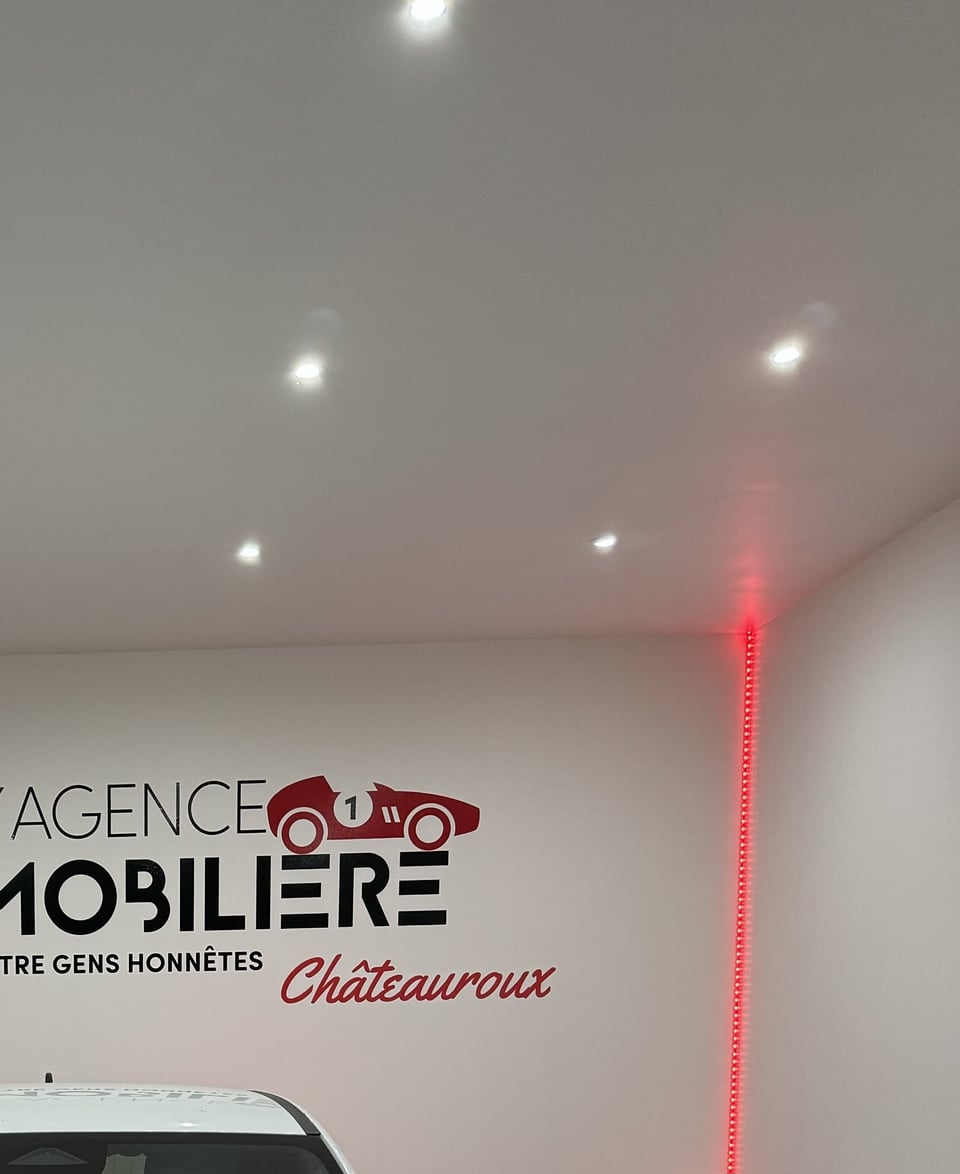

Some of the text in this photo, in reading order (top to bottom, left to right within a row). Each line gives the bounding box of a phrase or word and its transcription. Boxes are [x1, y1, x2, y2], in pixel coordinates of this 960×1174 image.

[345, 796, 357, 820] 1
[52, 953, 120, 975] GENS
[128, 946, 263, 973] HONNÊTES
[280, 953, 557, 1004] Châteauroux
